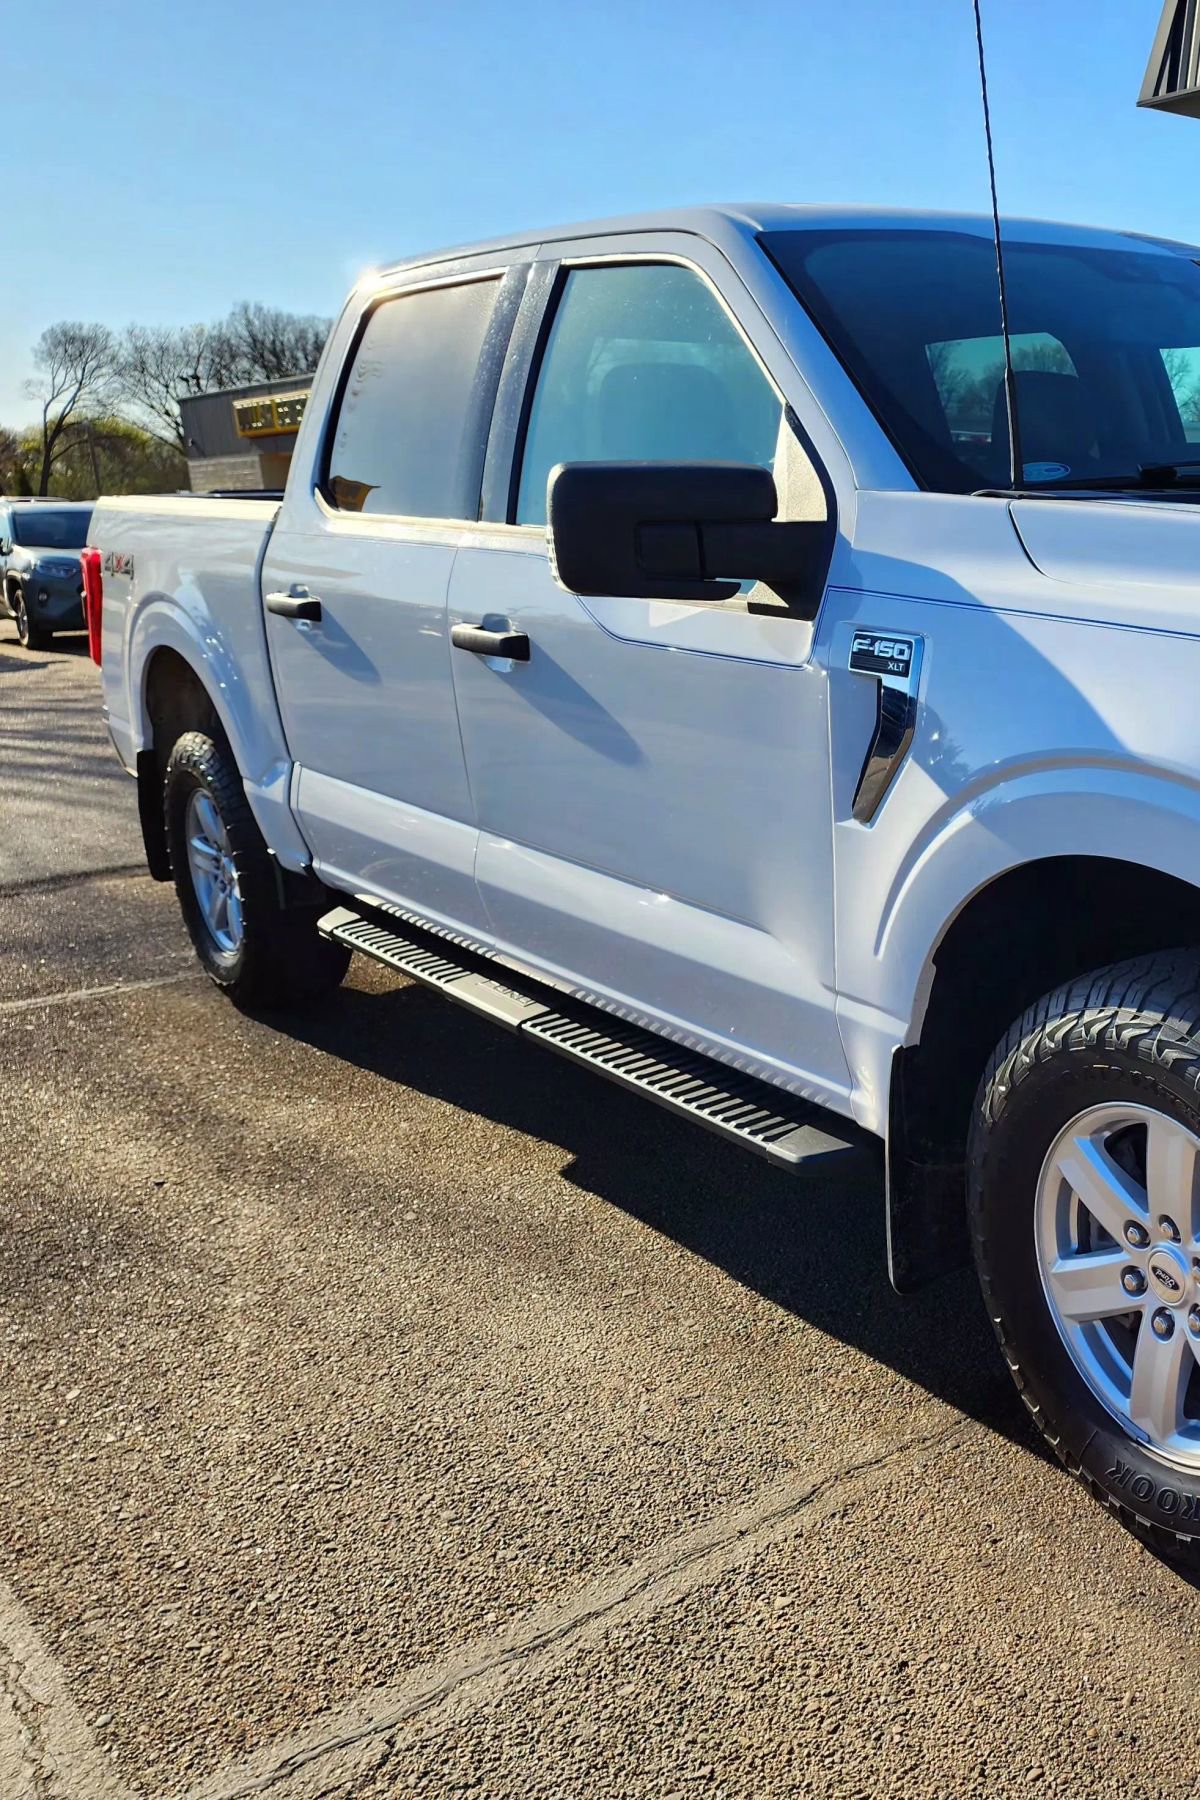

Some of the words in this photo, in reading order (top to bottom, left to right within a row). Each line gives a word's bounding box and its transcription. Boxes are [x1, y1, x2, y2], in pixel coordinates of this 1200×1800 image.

[852, 638, 911, 661] F-150
[887, 661, 905, 672] XLT
[1155, 1268, 1176, 1288] Ford
